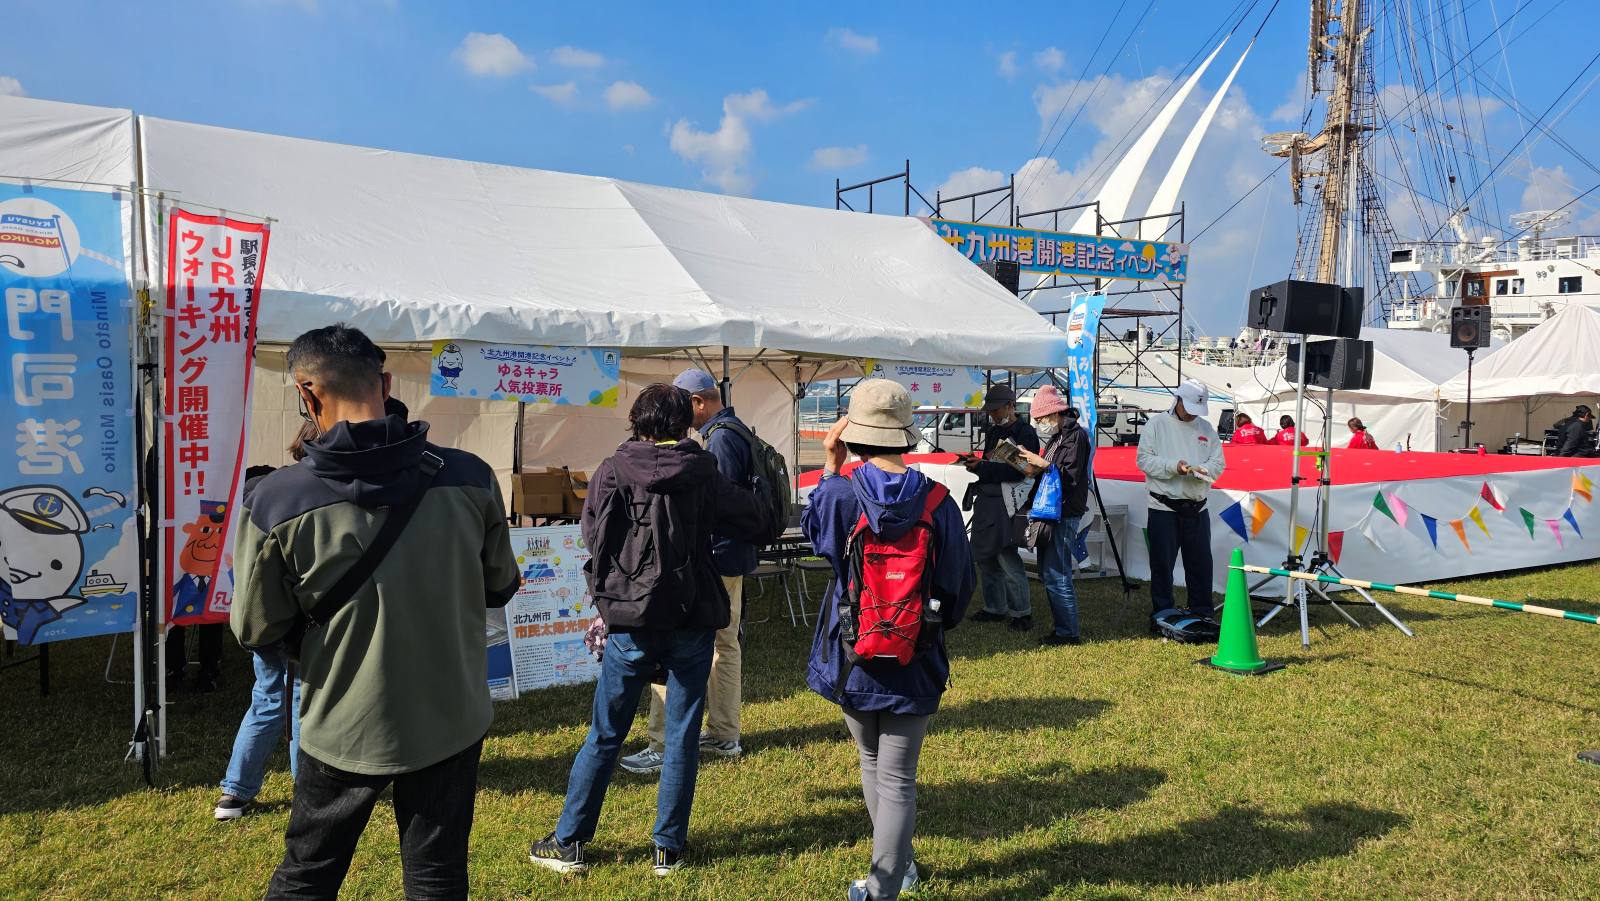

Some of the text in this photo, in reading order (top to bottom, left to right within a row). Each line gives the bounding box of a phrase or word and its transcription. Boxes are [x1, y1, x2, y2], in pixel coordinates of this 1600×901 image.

[208, 236, 241, 344] JR九州
[487, 348, 571, 362] 北九州港開港記念イベント
[497, 363, 560, 381] ゆるキャラ
[493, 379, 563, 397] 人気投票所
[513, 611, 551, 624] 北九州市
[514, 618, 593, 639] 市民太陽光発
